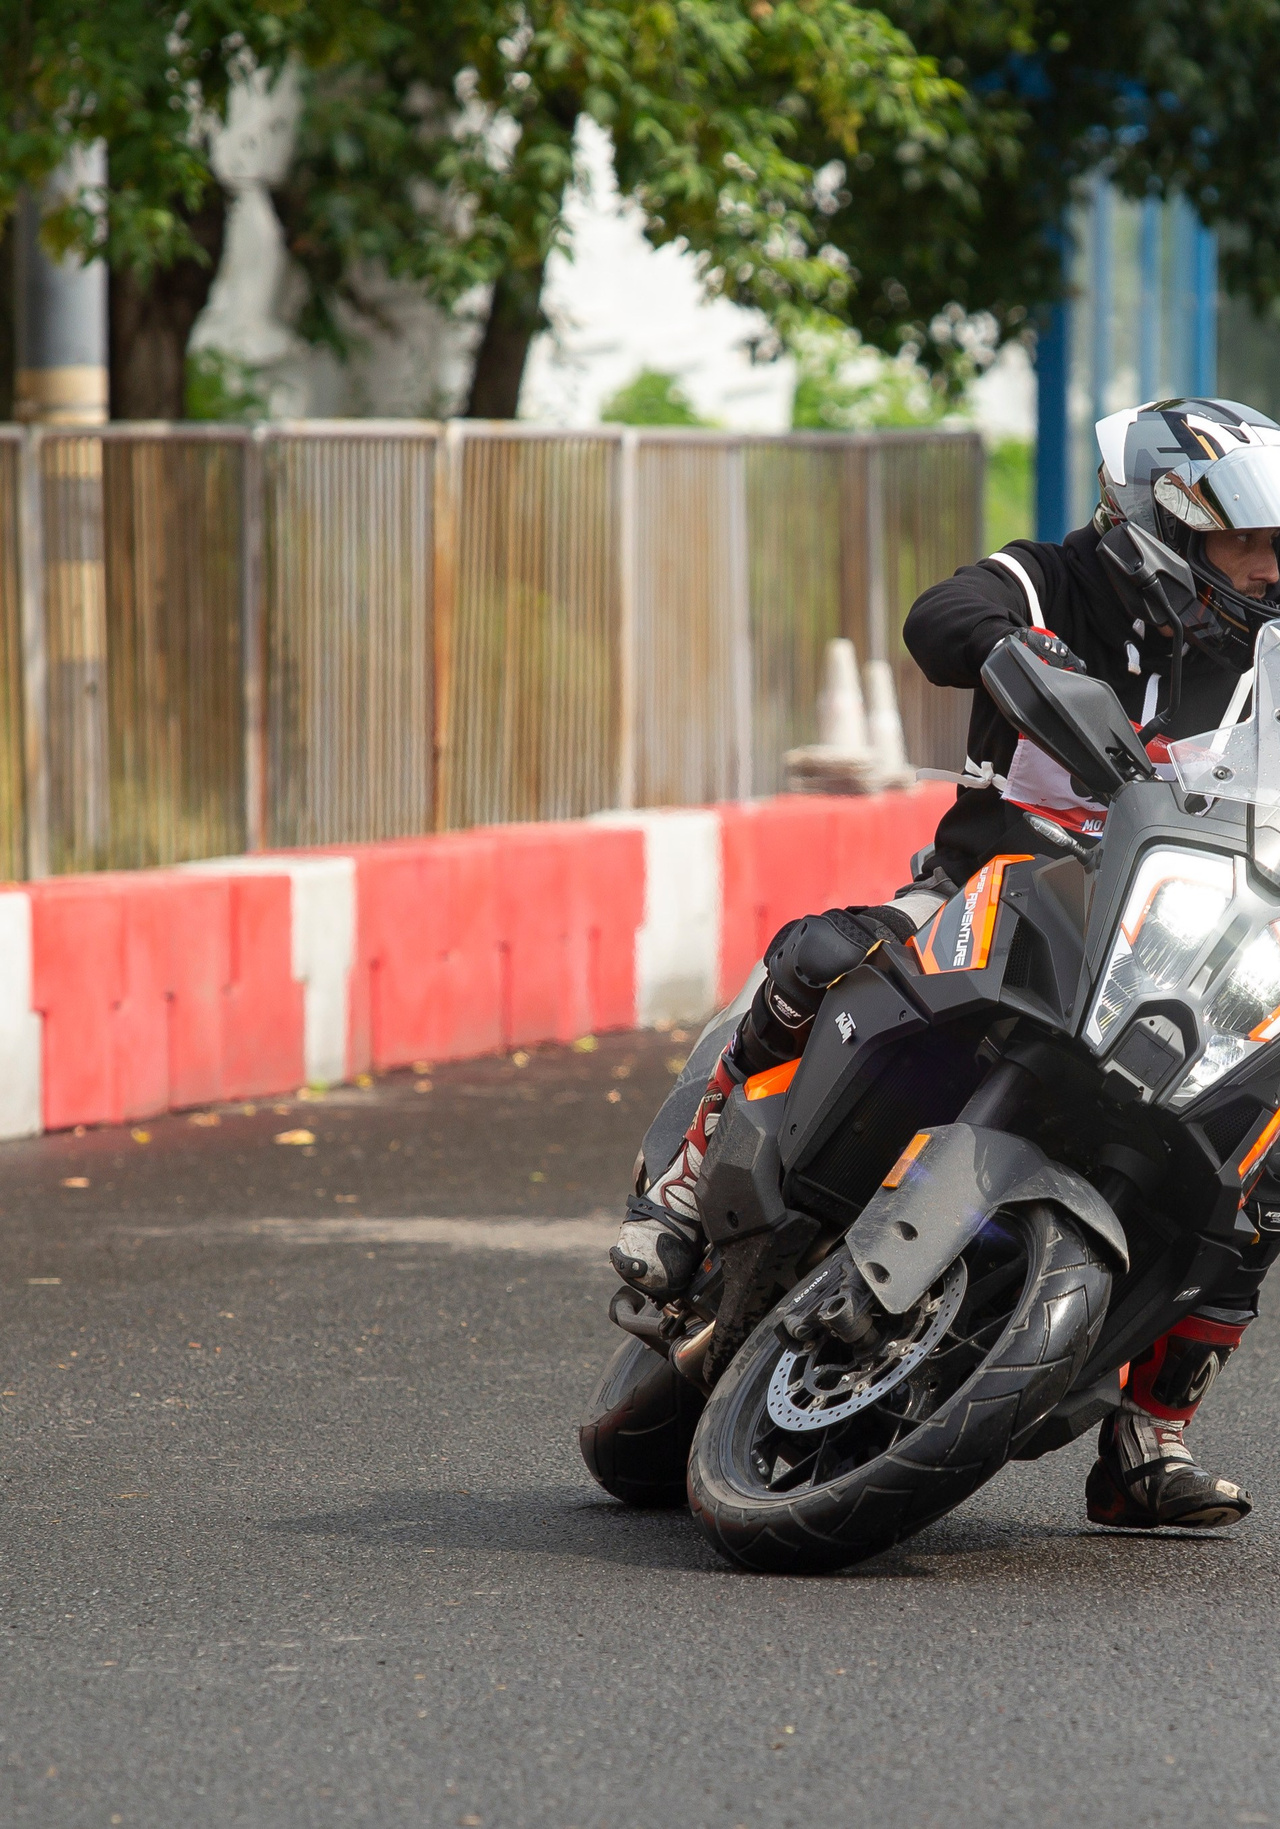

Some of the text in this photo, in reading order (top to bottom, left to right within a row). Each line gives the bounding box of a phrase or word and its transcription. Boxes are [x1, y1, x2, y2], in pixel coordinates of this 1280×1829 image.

[1081, 818, 1105, 832] MO
[952, 866, 989, 967] SUPER ADVENTURE
[773, 994, 802, 1018] KENNY
[834, 1011, 857, 1045] KTM
[793, 1270, 829, 1304] brembo
